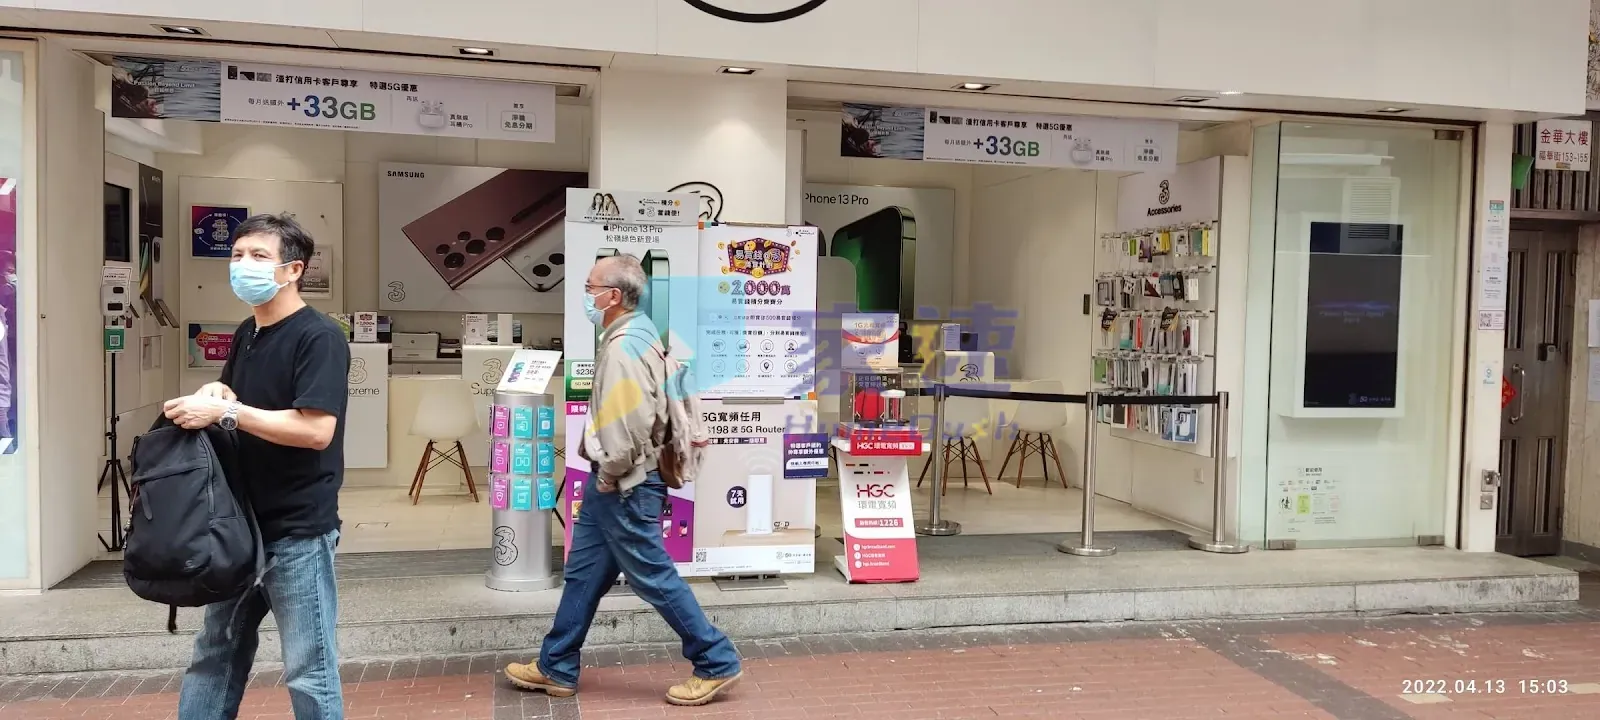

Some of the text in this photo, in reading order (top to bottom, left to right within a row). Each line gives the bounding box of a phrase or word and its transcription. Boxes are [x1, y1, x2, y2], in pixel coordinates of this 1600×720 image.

[287, 95, 376, 120] +33GB
[1540, 128, 1589, 146] 金華大樓
[973, 135, 1040, 157] +33GB
[387, 170, 425, 179] SAMSUNG
[838, 194, 849, 205] 13
[851, 194, 869, 205] Pro
[1147, 204, 1182, 217] Accessories
[609, 223, 663, 234] iPhone 13 Pro
[347, 387, 380, 397] preme
[702, 411, 761, 423] 5G寬頻任用
[741, 426, 753, 434] 5G
[755, 426, 786, 434] Router
[856, 442, 873, 450] HGC
[731, 489, 744, 497] 7天
[857, 484, 895, 498] HGC
[880, 519, 899, 527] 1226
